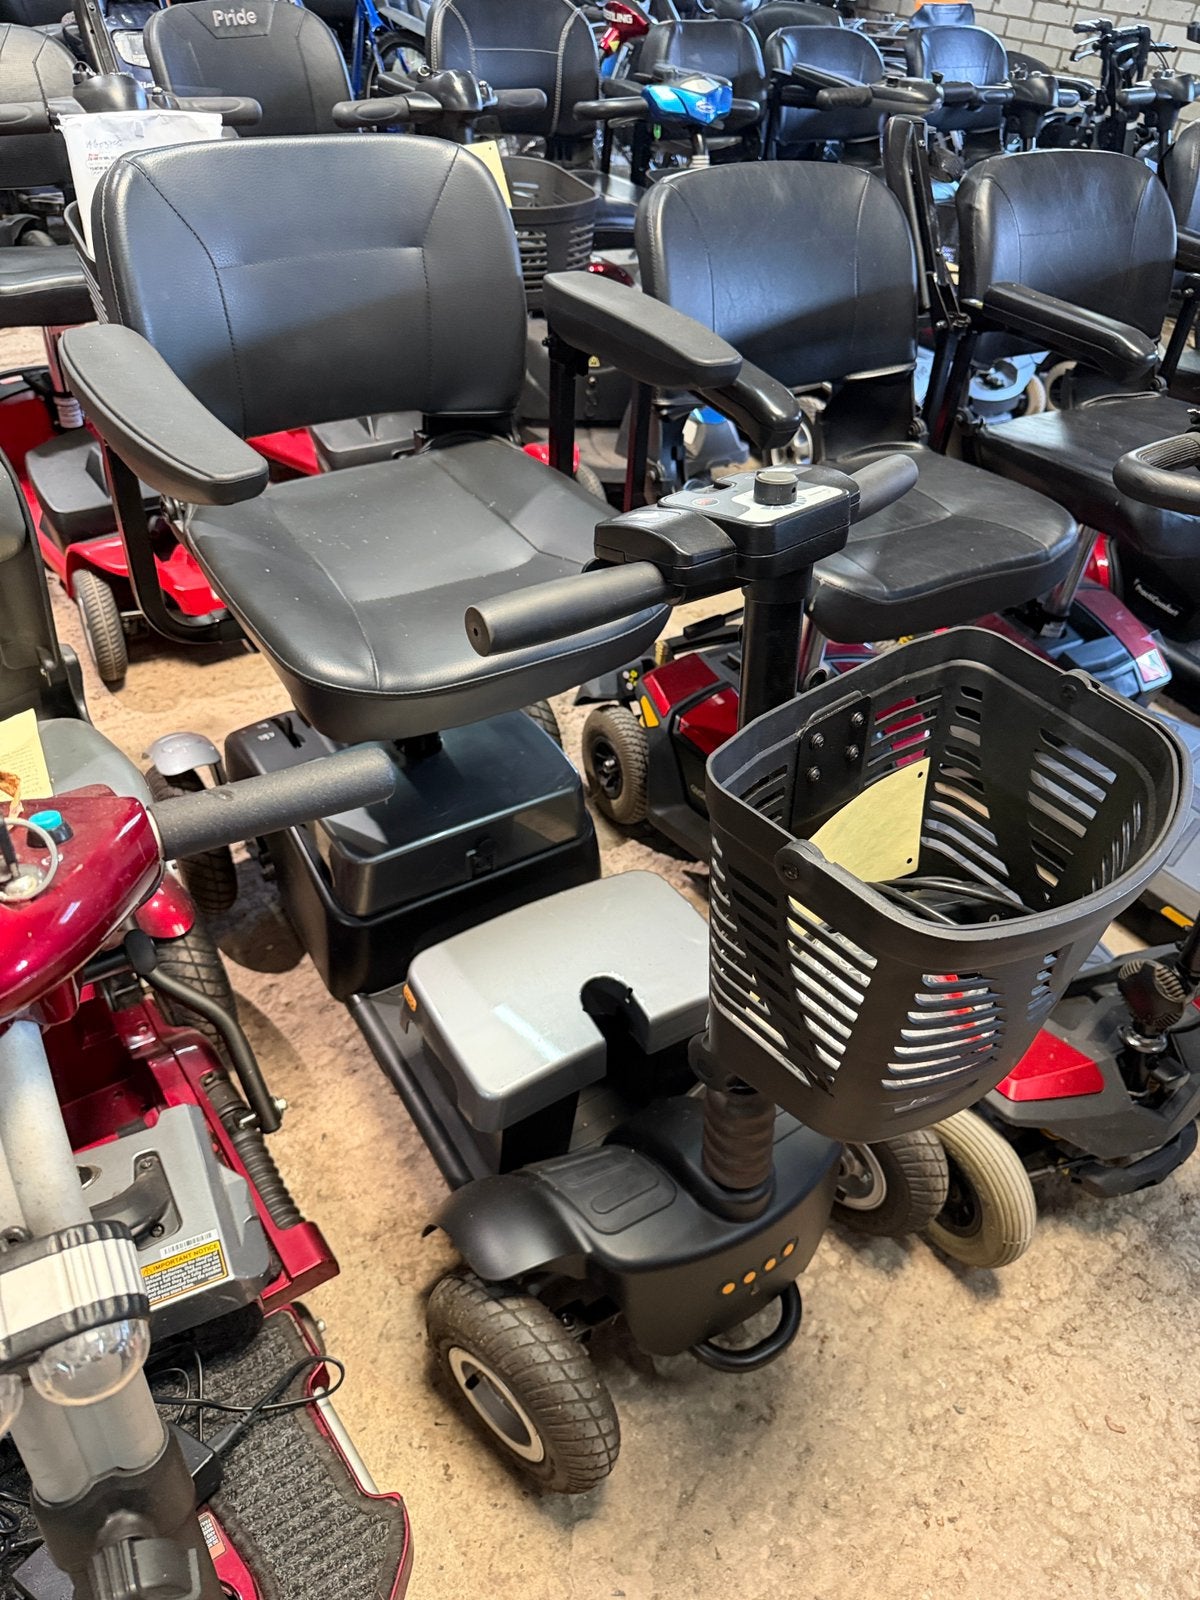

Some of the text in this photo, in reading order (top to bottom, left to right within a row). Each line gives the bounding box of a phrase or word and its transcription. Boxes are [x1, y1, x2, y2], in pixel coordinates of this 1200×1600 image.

[212, 8, 257, 27] Pride
[152, 1251, 192, 1271] IMPORTANT
[192, 1242, 218, 1257] NOTICE
